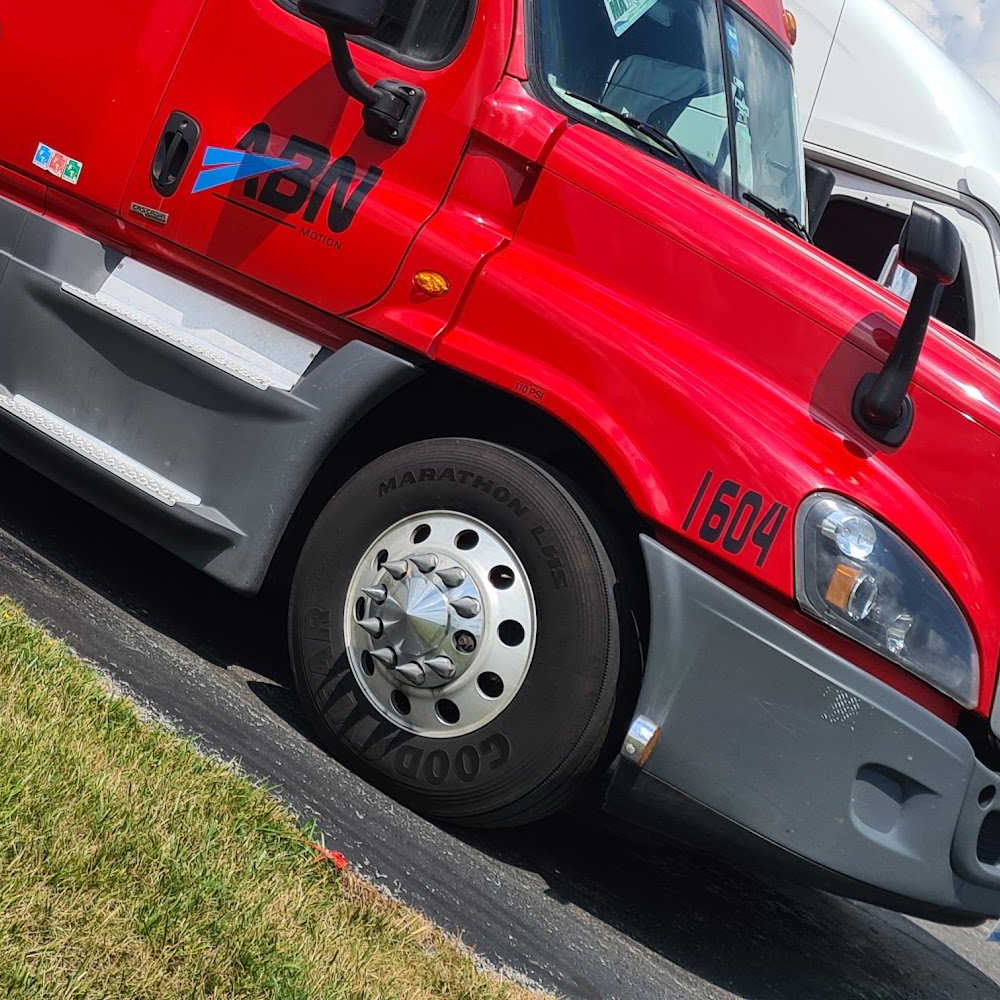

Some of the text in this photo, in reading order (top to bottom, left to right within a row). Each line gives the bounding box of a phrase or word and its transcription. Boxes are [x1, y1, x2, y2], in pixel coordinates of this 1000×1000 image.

[233, 122, 384, 233] ABN
[300, 227, 342, 250] MOTION
[514, 382, 545, 400] 110 PSI
[377, 467, 568, 591] MARATHON LHS
[681, 470, 789, 568] 1604
